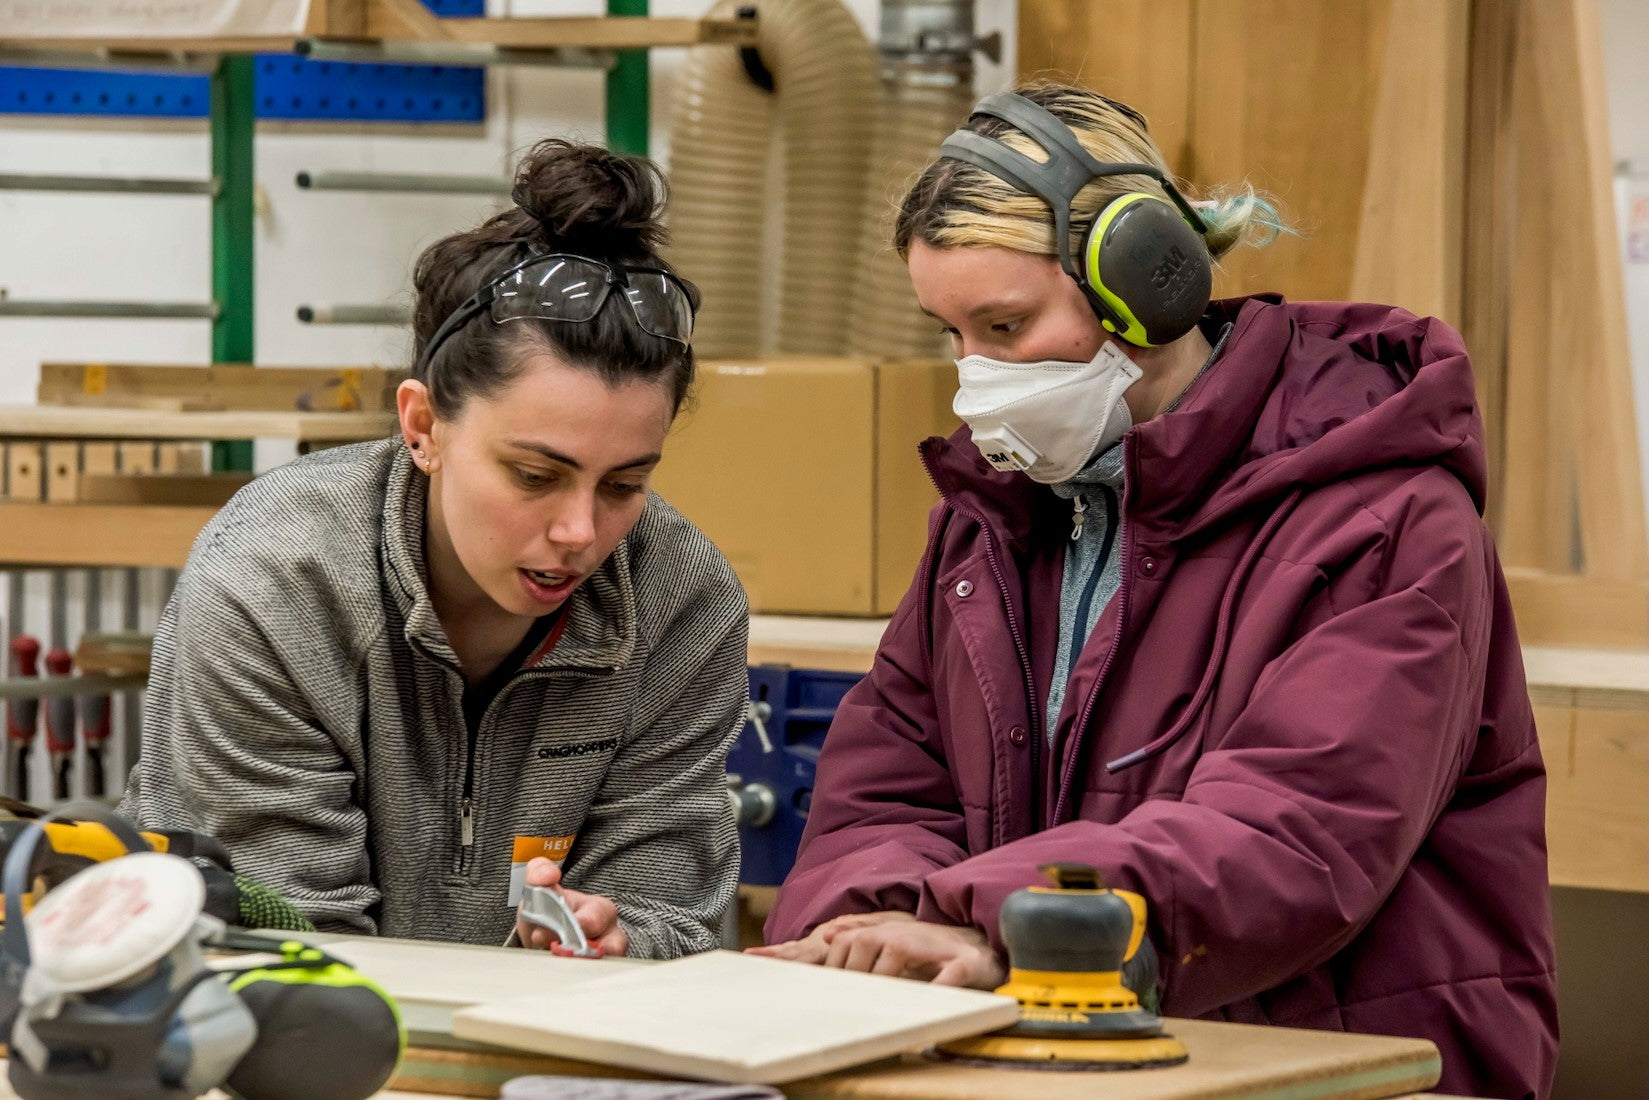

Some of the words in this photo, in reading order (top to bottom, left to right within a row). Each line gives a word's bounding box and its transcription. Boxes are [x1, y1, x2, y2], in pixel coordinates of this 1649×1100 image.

[1151, 246, 1187, 290] 3M
[987, 452, 1010, 463] 3M
[543, 838, 574, 850] HEL
